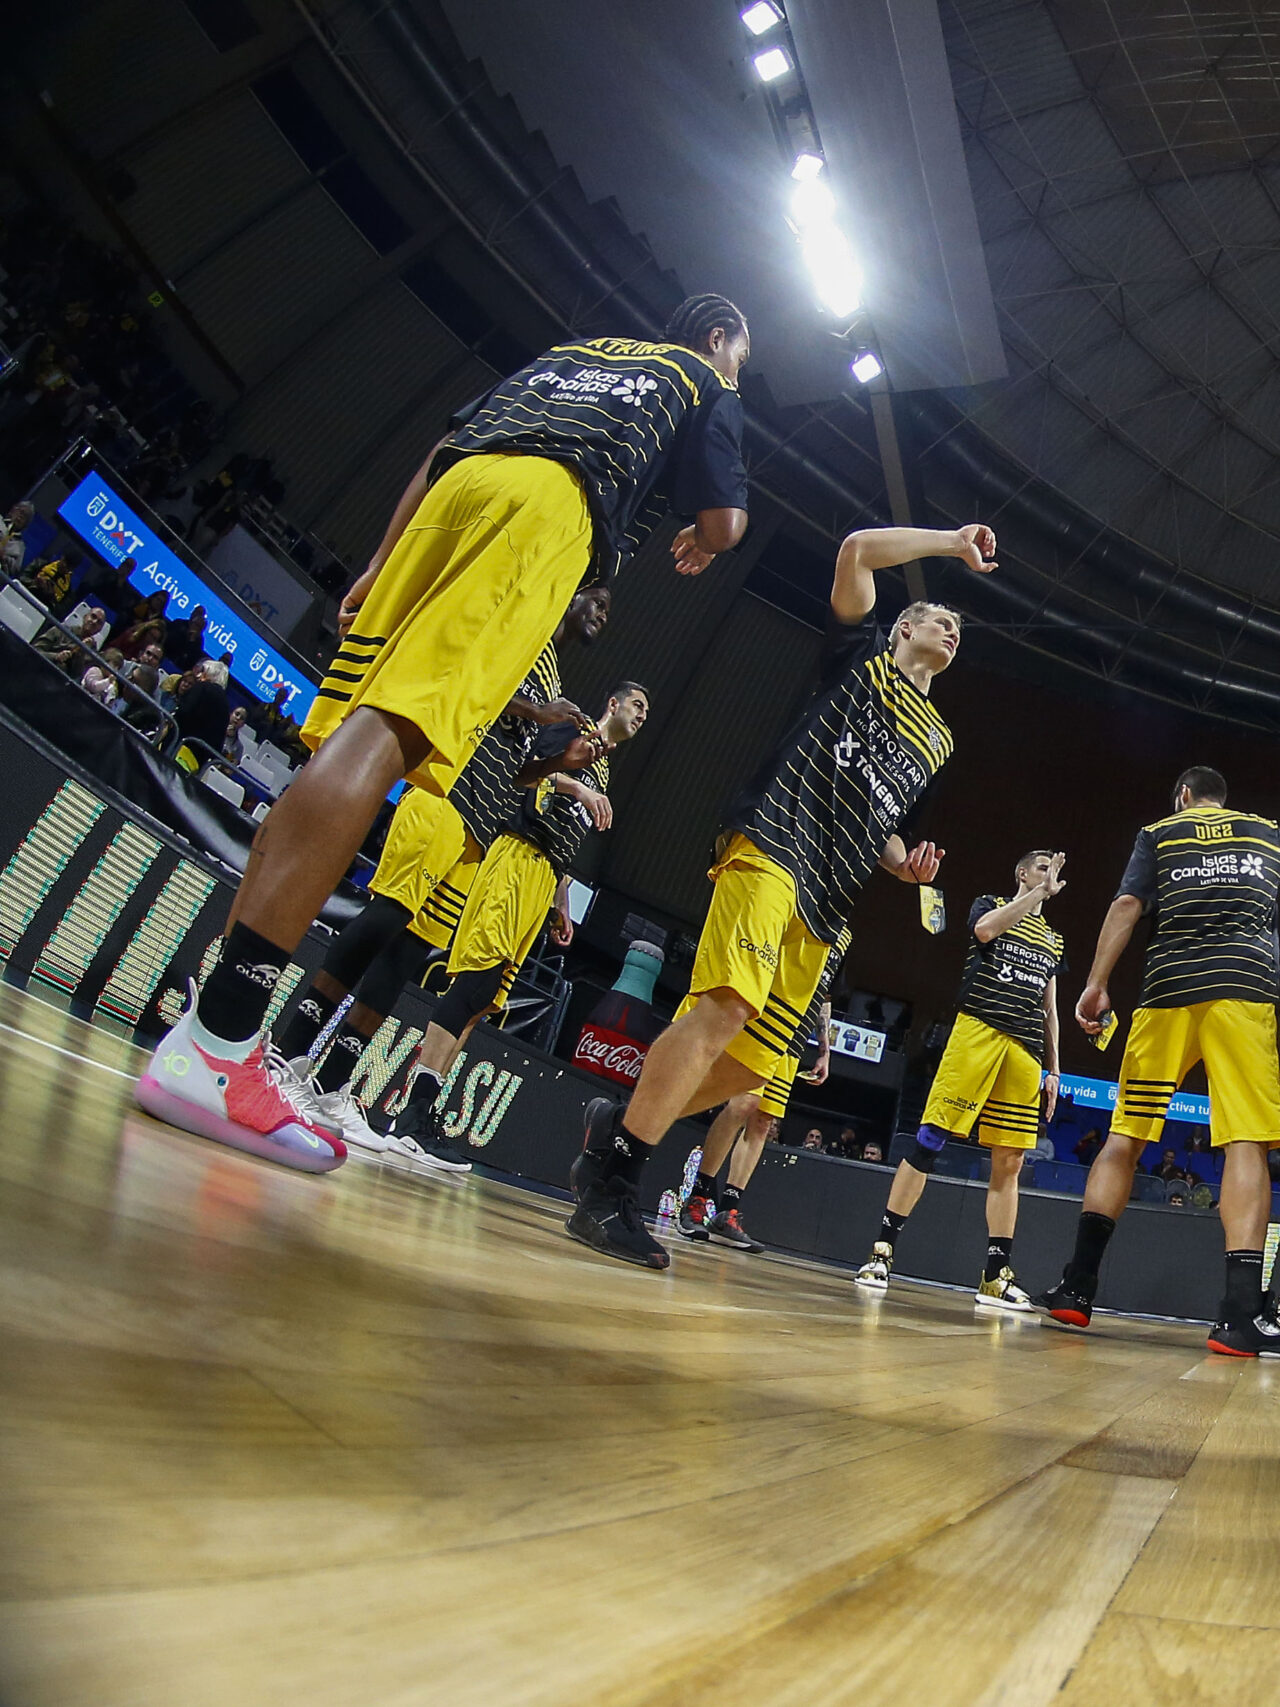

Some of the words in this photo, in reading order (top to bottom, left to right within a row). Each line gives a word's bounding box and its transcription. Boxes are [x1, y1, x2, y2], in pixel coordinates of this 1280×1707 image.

[528, 371, 612, 393] Canarias
[575, 368, 623, 384] Islas
[99, 510, 144, 554] DXT
[92, 526, 127, 563] TENERIFE
[143, 561, 189, 609] Activa
[208, 621, 238, 653] vida
[262, 664, 302, 701] DXT
[857, 755, 900, 817] TENERIF
[1195, 823, 1233, 839] DIEZ
[1202, 855, 1237, 867] Islas
[1171, 864, 1238, 881] Canarias
[576, 1032, 645, 1078] Coca-Cola
[1060, 1083, 1071, 1094] tu
[1074, 1086, 1097, 1099] vida
[1170, 1101, 1196, 1114] ctiva
[1198, 1105, 1210, 1115] tu
